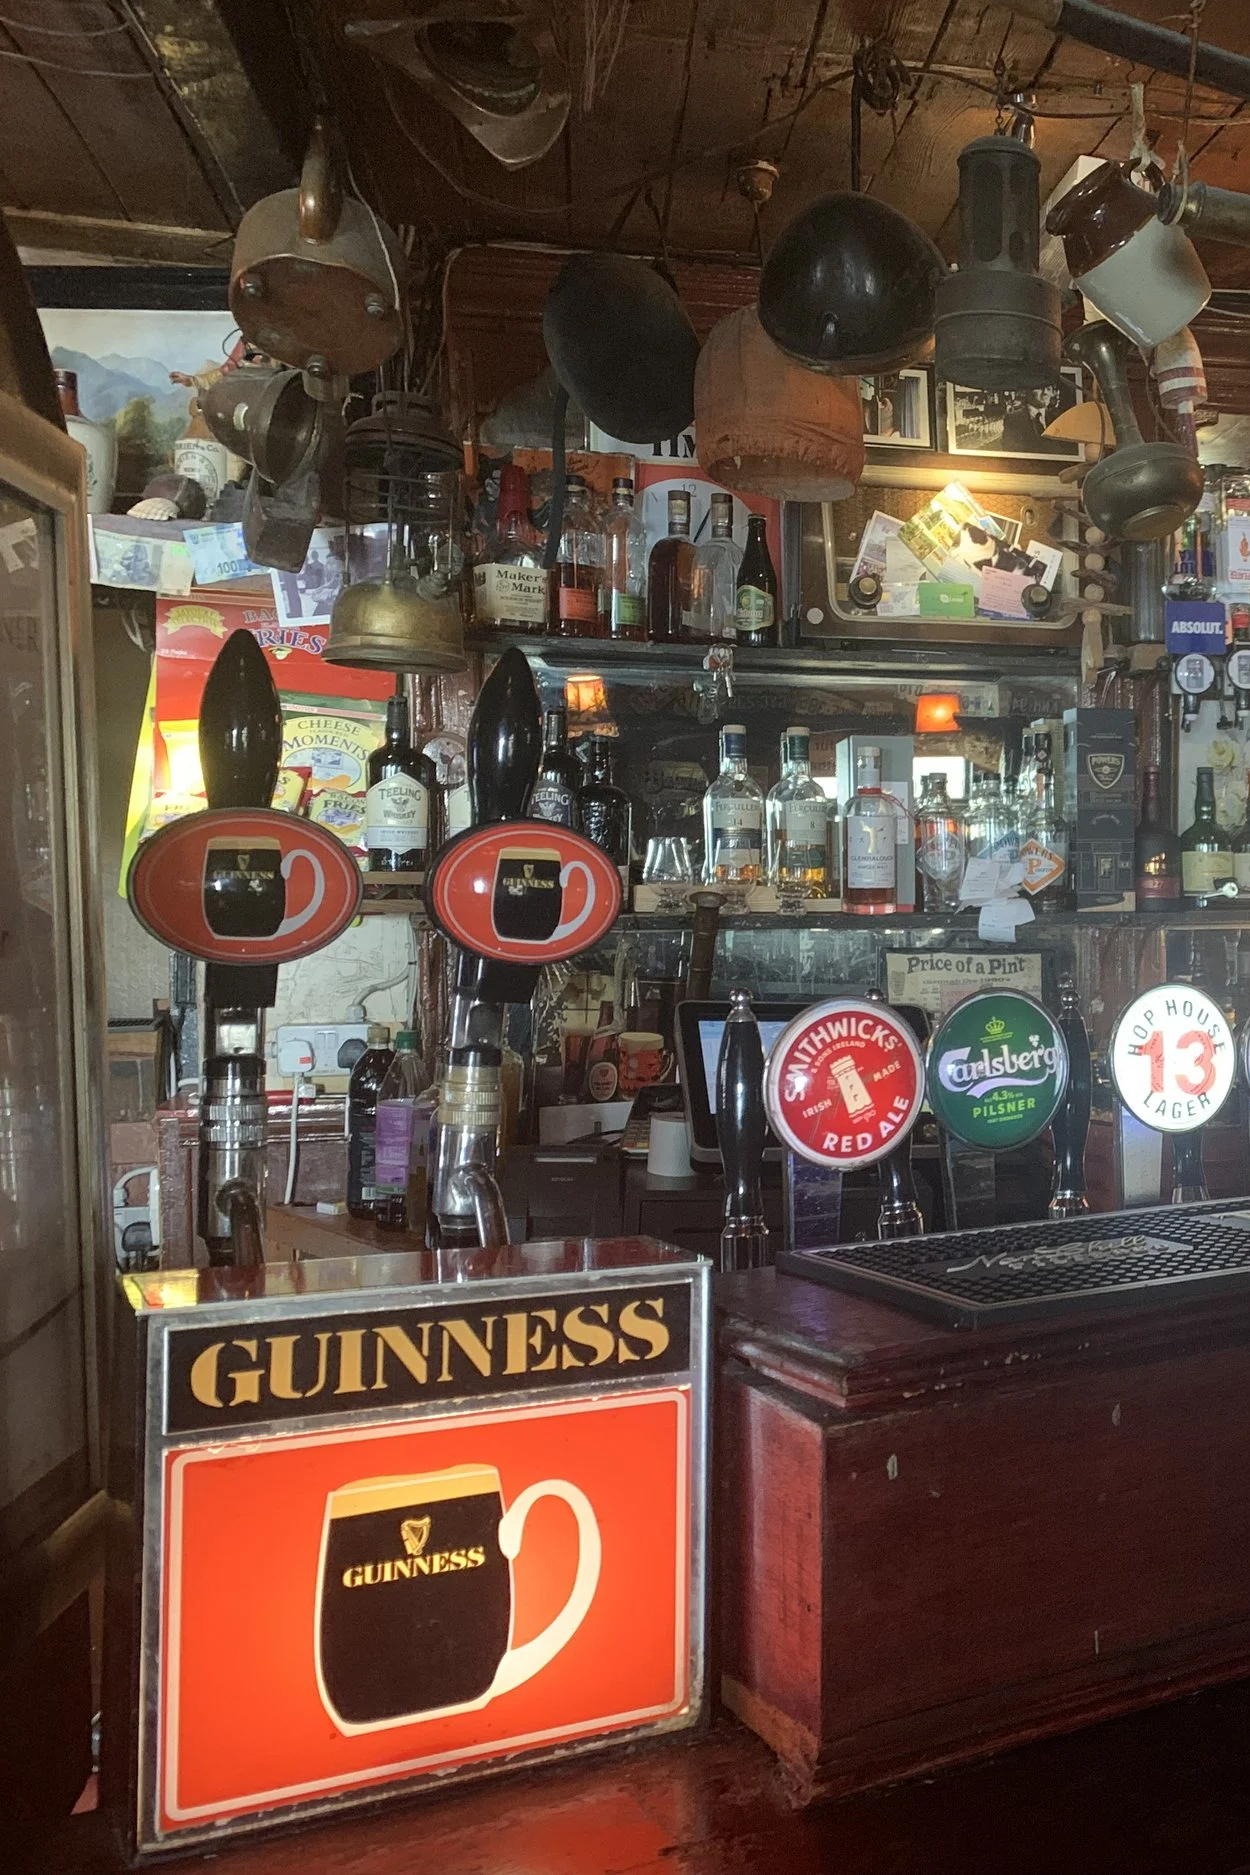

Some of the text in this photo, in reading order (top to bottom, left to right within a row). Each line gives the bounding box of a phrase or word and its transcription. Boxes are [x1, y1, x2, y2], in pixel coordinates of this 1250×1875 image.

[681, 483, 697, 498] 12
[216, 561, 239, 575] 100
[511, 582, 545, 595] Mark
[252, 628, 327, 655] RIES
[297, 719, 361, 736] CHEESE
[282, 735, 370, 761] MOMENTS
[377, 787, 422, 801] TEELING
[531, 792, 570, 805] TEELING
[1027, 858, 1041, 875] P
[503, 877, 555, 889] GUINNESS
[907, 953, 1026, 976] Price of a Pint
[1127, 999, 1227, 1057] HOP HOUSE
[938, 1041, 1060, 1093] Carlsberg
[1140, 1030, 1217, 1095] 13
[802, 1098, 833, 1119] IRISH
[873, 1060, 902, 1082] MADE
[972, 1097, 1036, 1118] PILSNER
[1144, 1090, 1211, 1119] LAGER
[822, 1132, 874, 1153] RED
[878, 1095, 910, 1139] ALE
[189, 1297, 671, 1409] GUINNESS
[342, 1544, 486, 1590] GUINNESS
